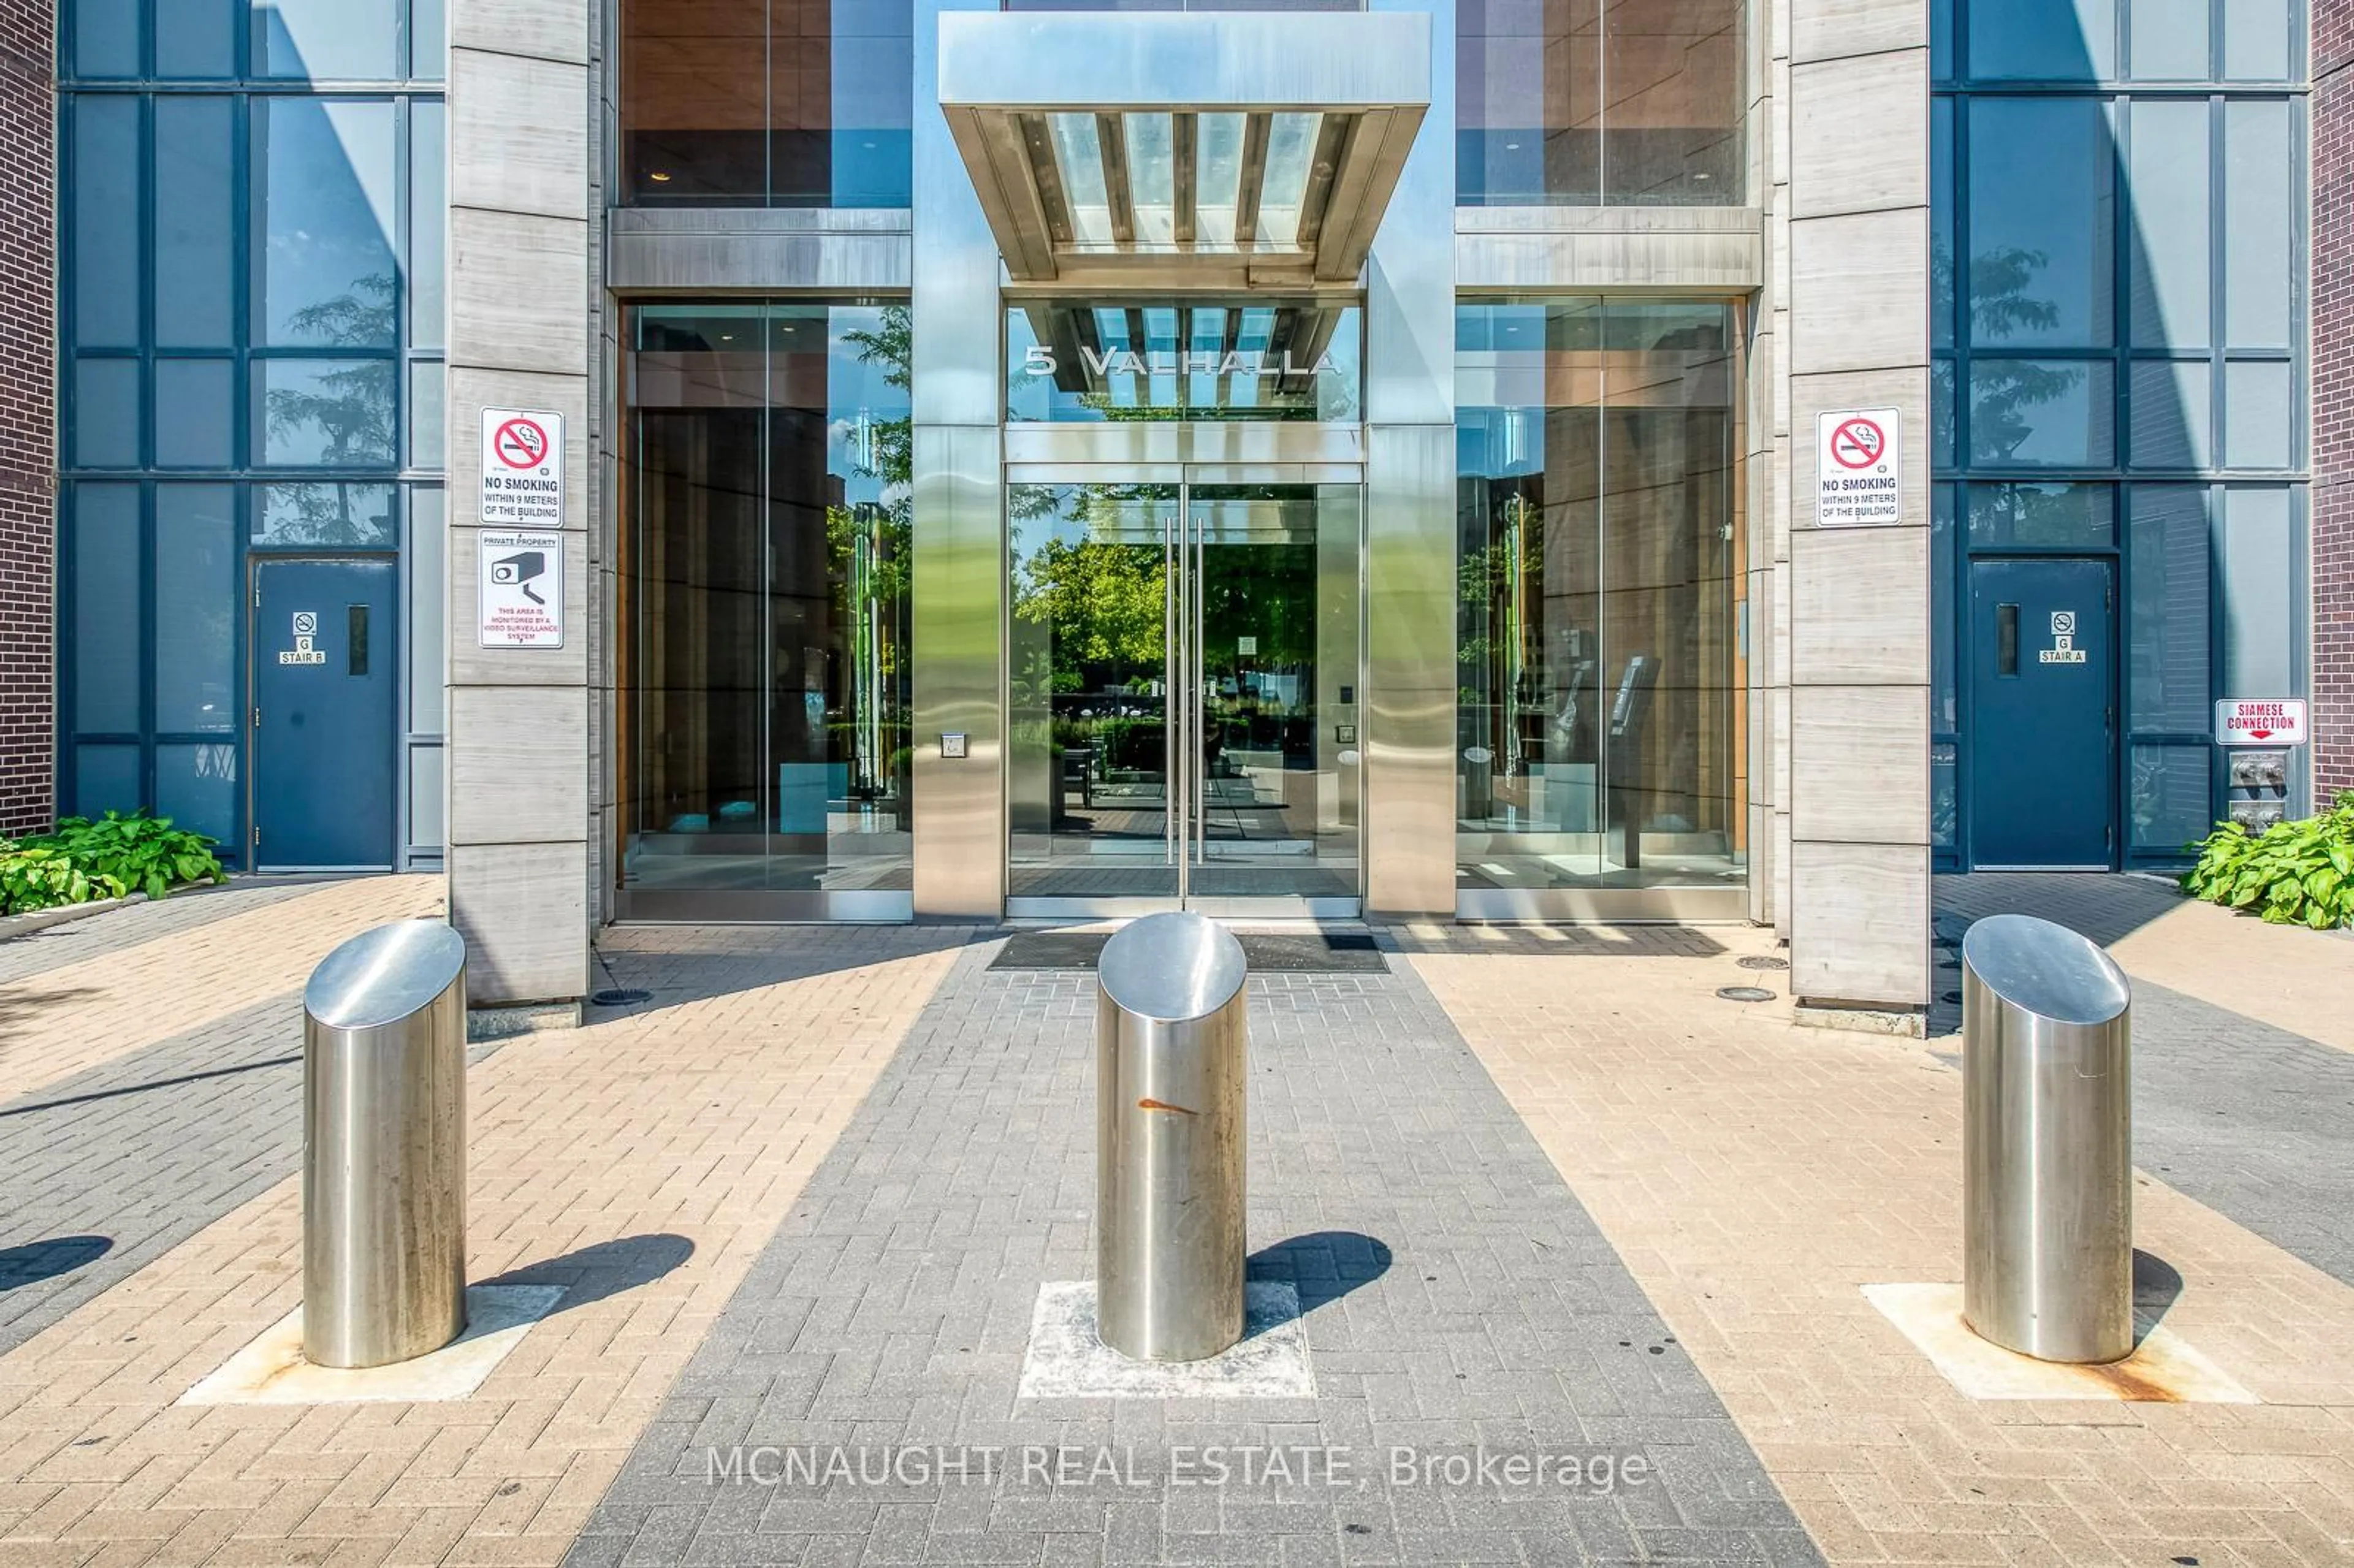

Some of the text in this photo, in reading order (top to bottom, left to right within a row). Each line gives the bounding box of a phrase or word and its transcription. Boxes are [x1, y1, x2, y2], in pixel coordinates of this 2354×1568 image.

[1025, 346, 1343, 375] 5 VALHALLA
[486, 477, 557, 492] NO SMOKING
[1823, 478, 1896, 491] NO SMOKING
[484, 493, 558, 505] WITHIN 9 METERS
[1822, 493, 1896, 504] WITHIN 9 METERS
[499, 507, 515, 516] THE
[518, 508, 557, 517] BUILDING
[1823, 506, 1895, 517] OF THE BUILDING
[300, 639, 308, 650] G
[2060, 638, 2068, 649] G
[283, 653, 312, 663] STAIR
[2042, 652, 2082, 661] STAIR A
[2238, 704, 2284, 715] SIAMESE
[2226, 717, 2295, 729] CONNECTION
